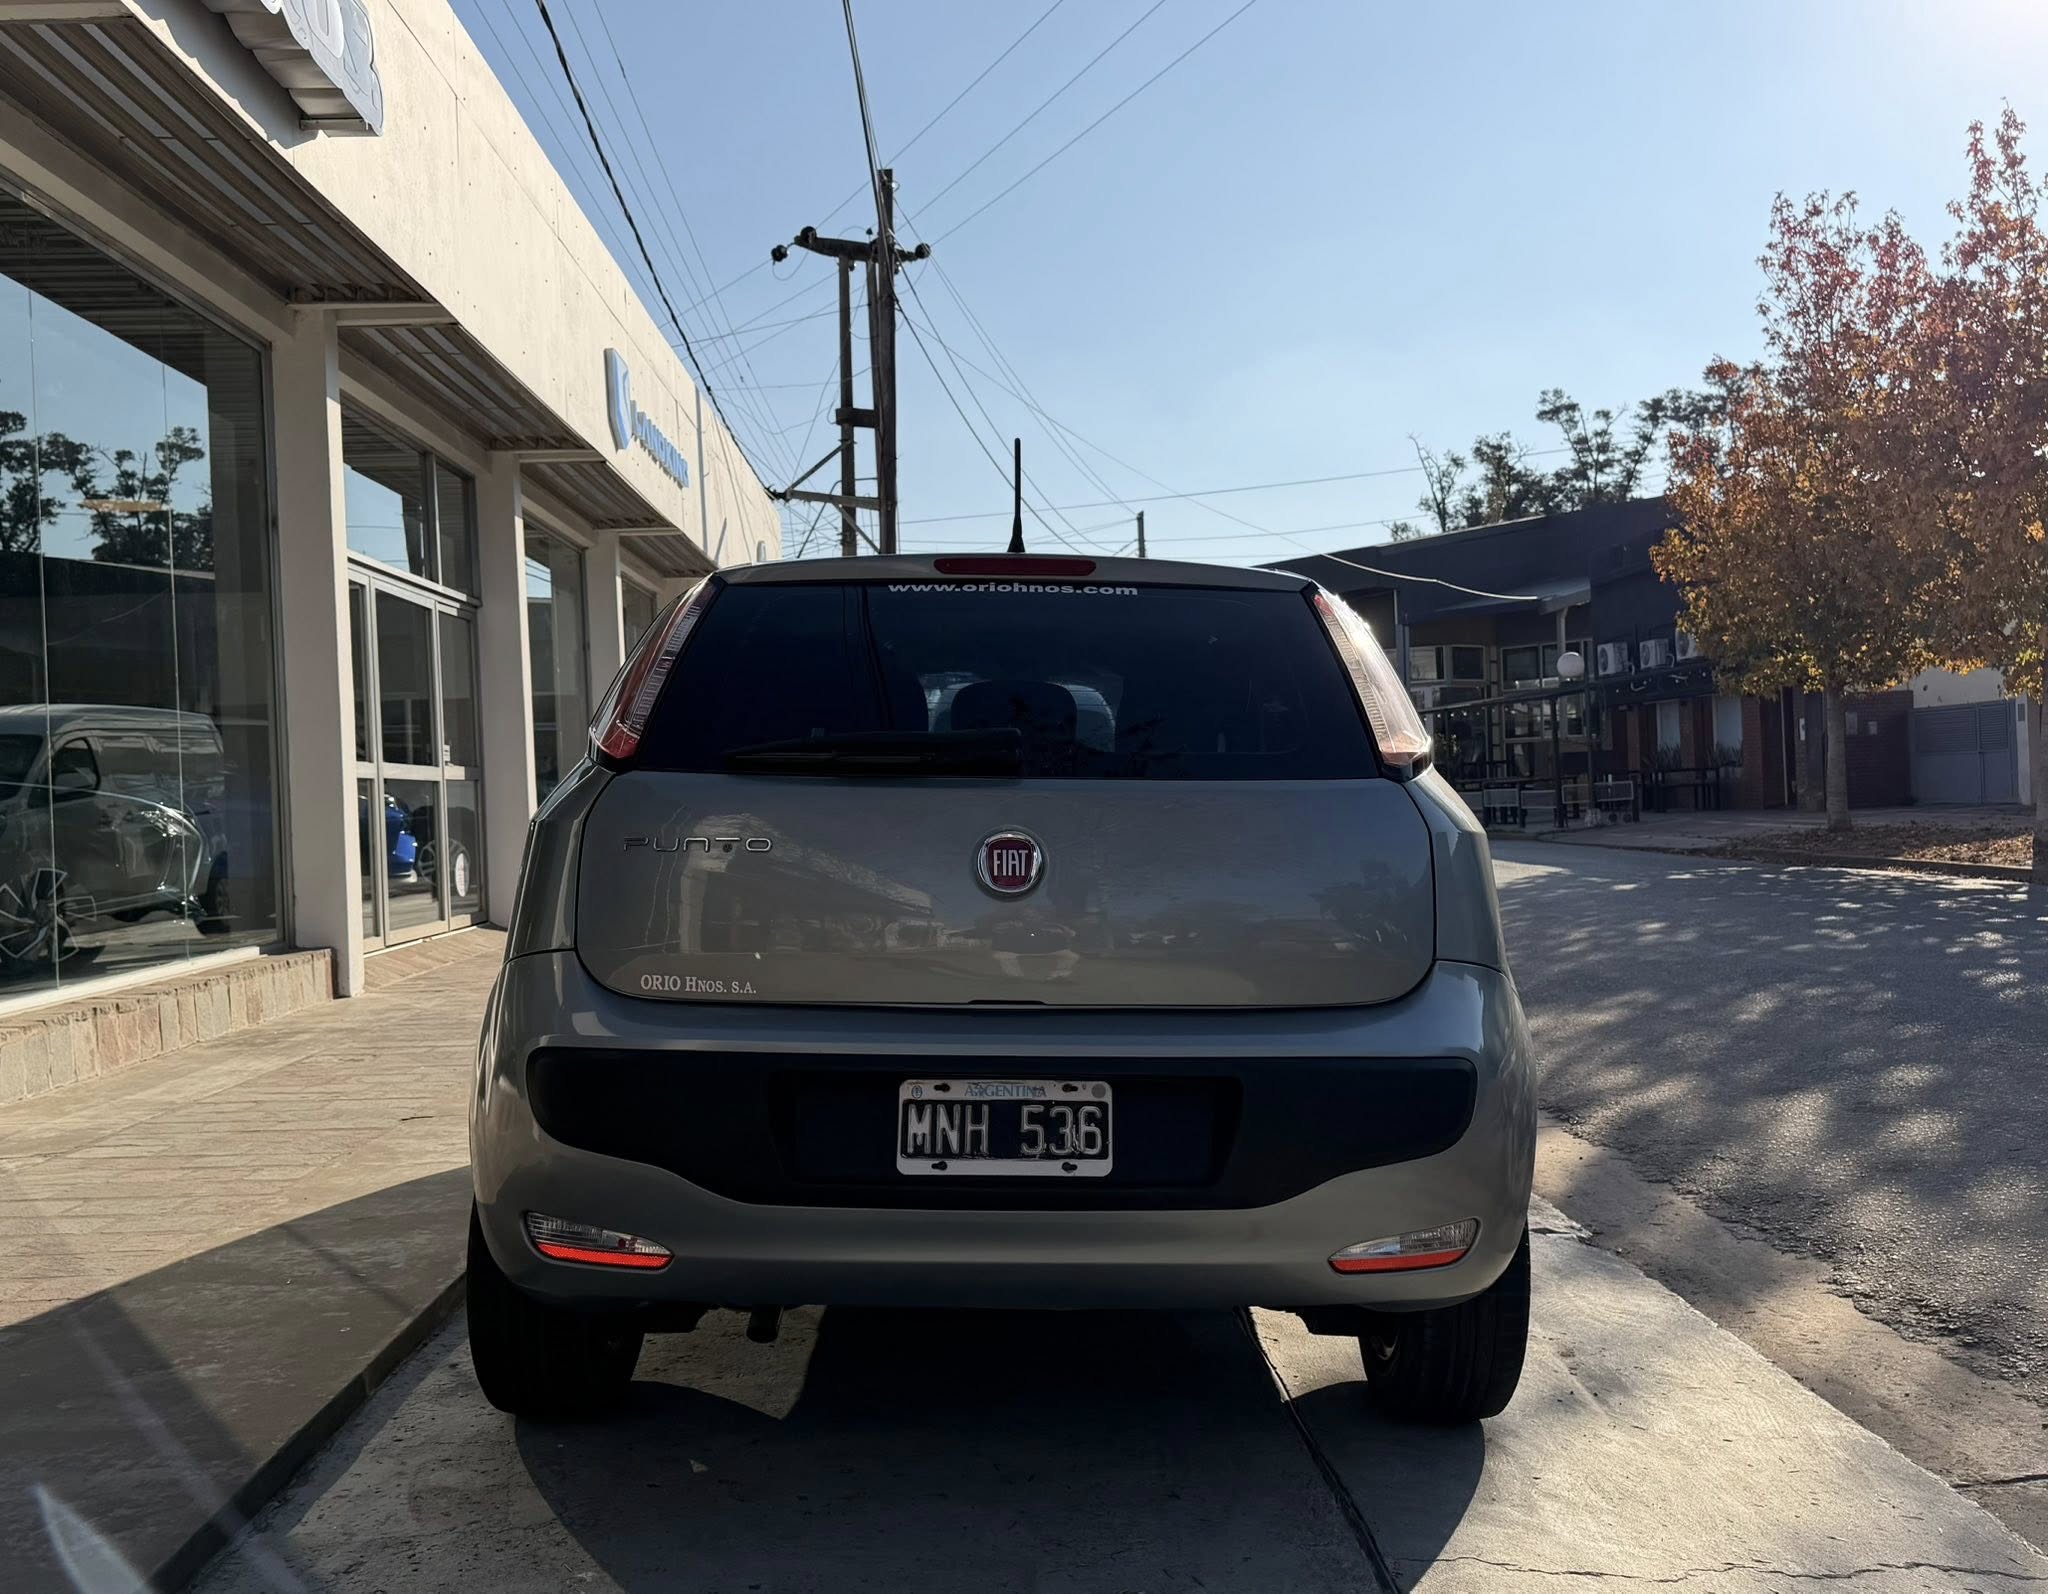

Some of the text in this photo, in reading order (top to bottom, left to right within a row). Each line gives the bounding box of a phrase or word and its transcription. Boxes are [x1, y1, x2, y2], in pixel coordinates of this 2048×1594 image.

[888, 582, 1138, 595] www.oriohnos.com
[993, 849, 1028, 876] FIAT
[640, 974, 681, 991] ORIO
[731, 981, 757, 994] S.A.
[965, 1082, 1047, 1098] ARGENTINA
[907, 1103, 1102, 1155] MNH 536
